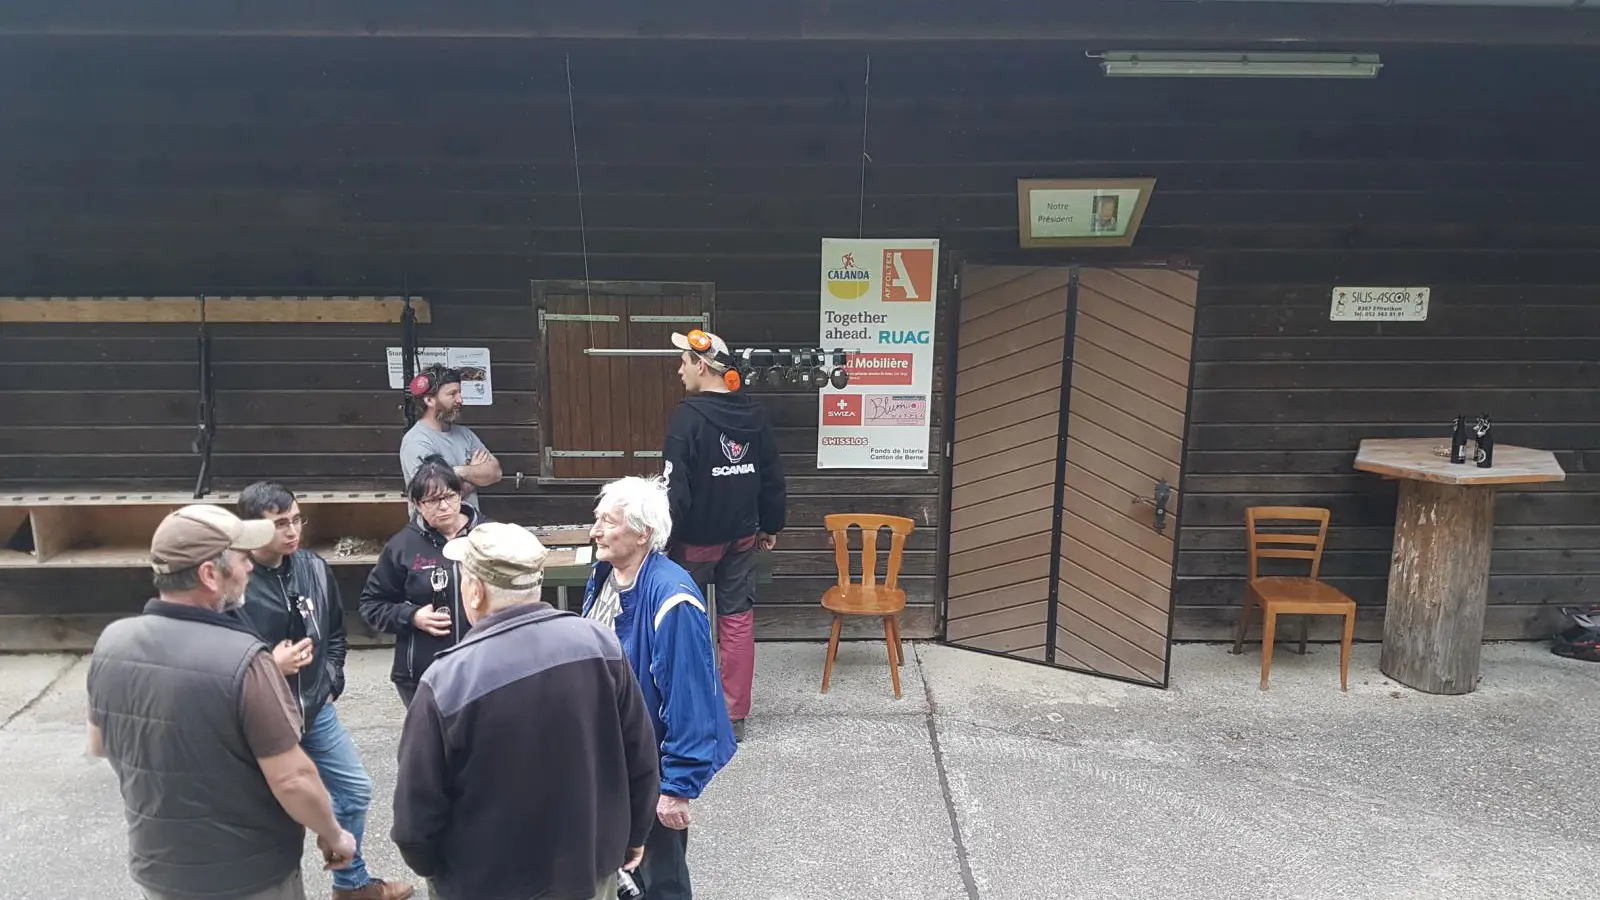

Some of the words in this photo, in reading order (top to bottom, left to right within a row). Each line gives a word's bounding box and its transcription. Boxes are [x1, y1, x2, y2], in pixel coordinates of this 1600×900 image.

[1047, 202, 1069, 210] Notre
[1038, 215, 1073, 223] Président
[827, 270, 870, 280] CALANDA
[885, 252, 893, 299] AFFOLTER
[824, 310, 888, 326] Together
[825, 327, 872, 340] ahead.
[879, 330, 930, 344] RUAG
[855, 357, 909, 369] Mobilière
[822, 437, 868, 446] SWISSLOS
[711, 463, 756, 477] SCANIA
